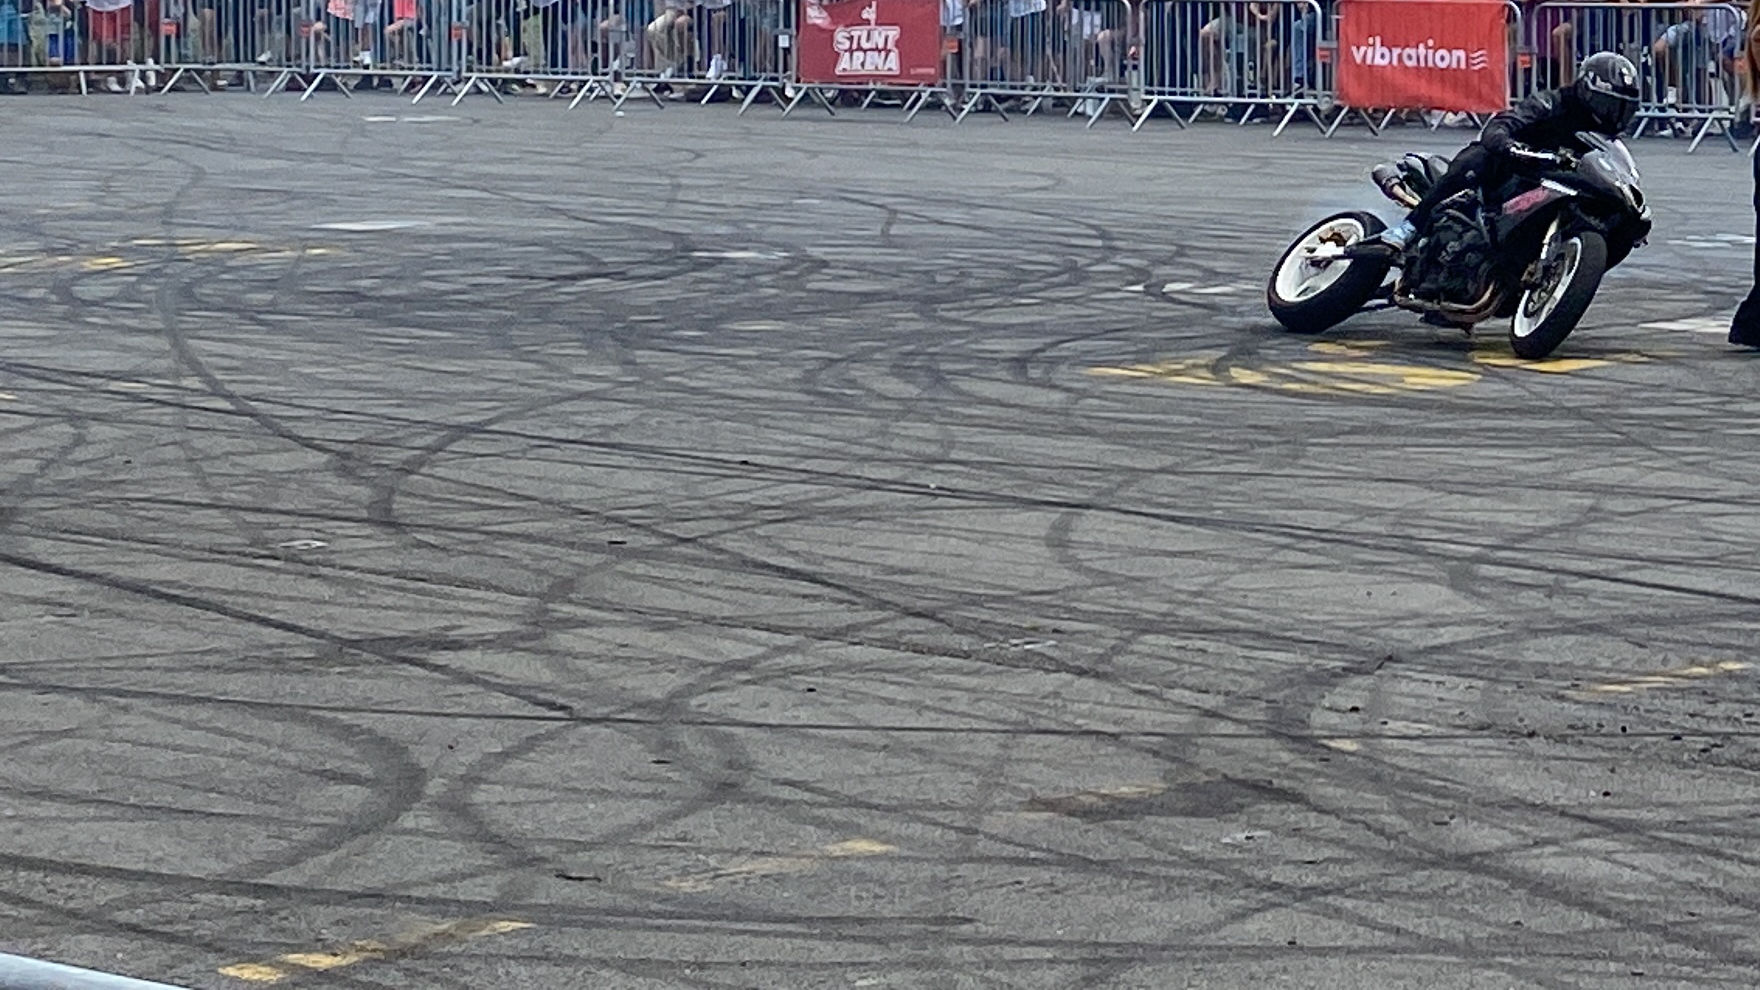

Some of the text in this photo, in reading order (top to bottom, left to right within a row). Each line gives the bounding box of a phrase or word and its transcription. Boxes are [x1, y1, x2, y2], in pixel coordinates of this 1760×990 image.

[835, 27, 899, 50] STUNT
[838, 50, 898, 71] ARENA
[1351, 36, 1467, 70] vibration
